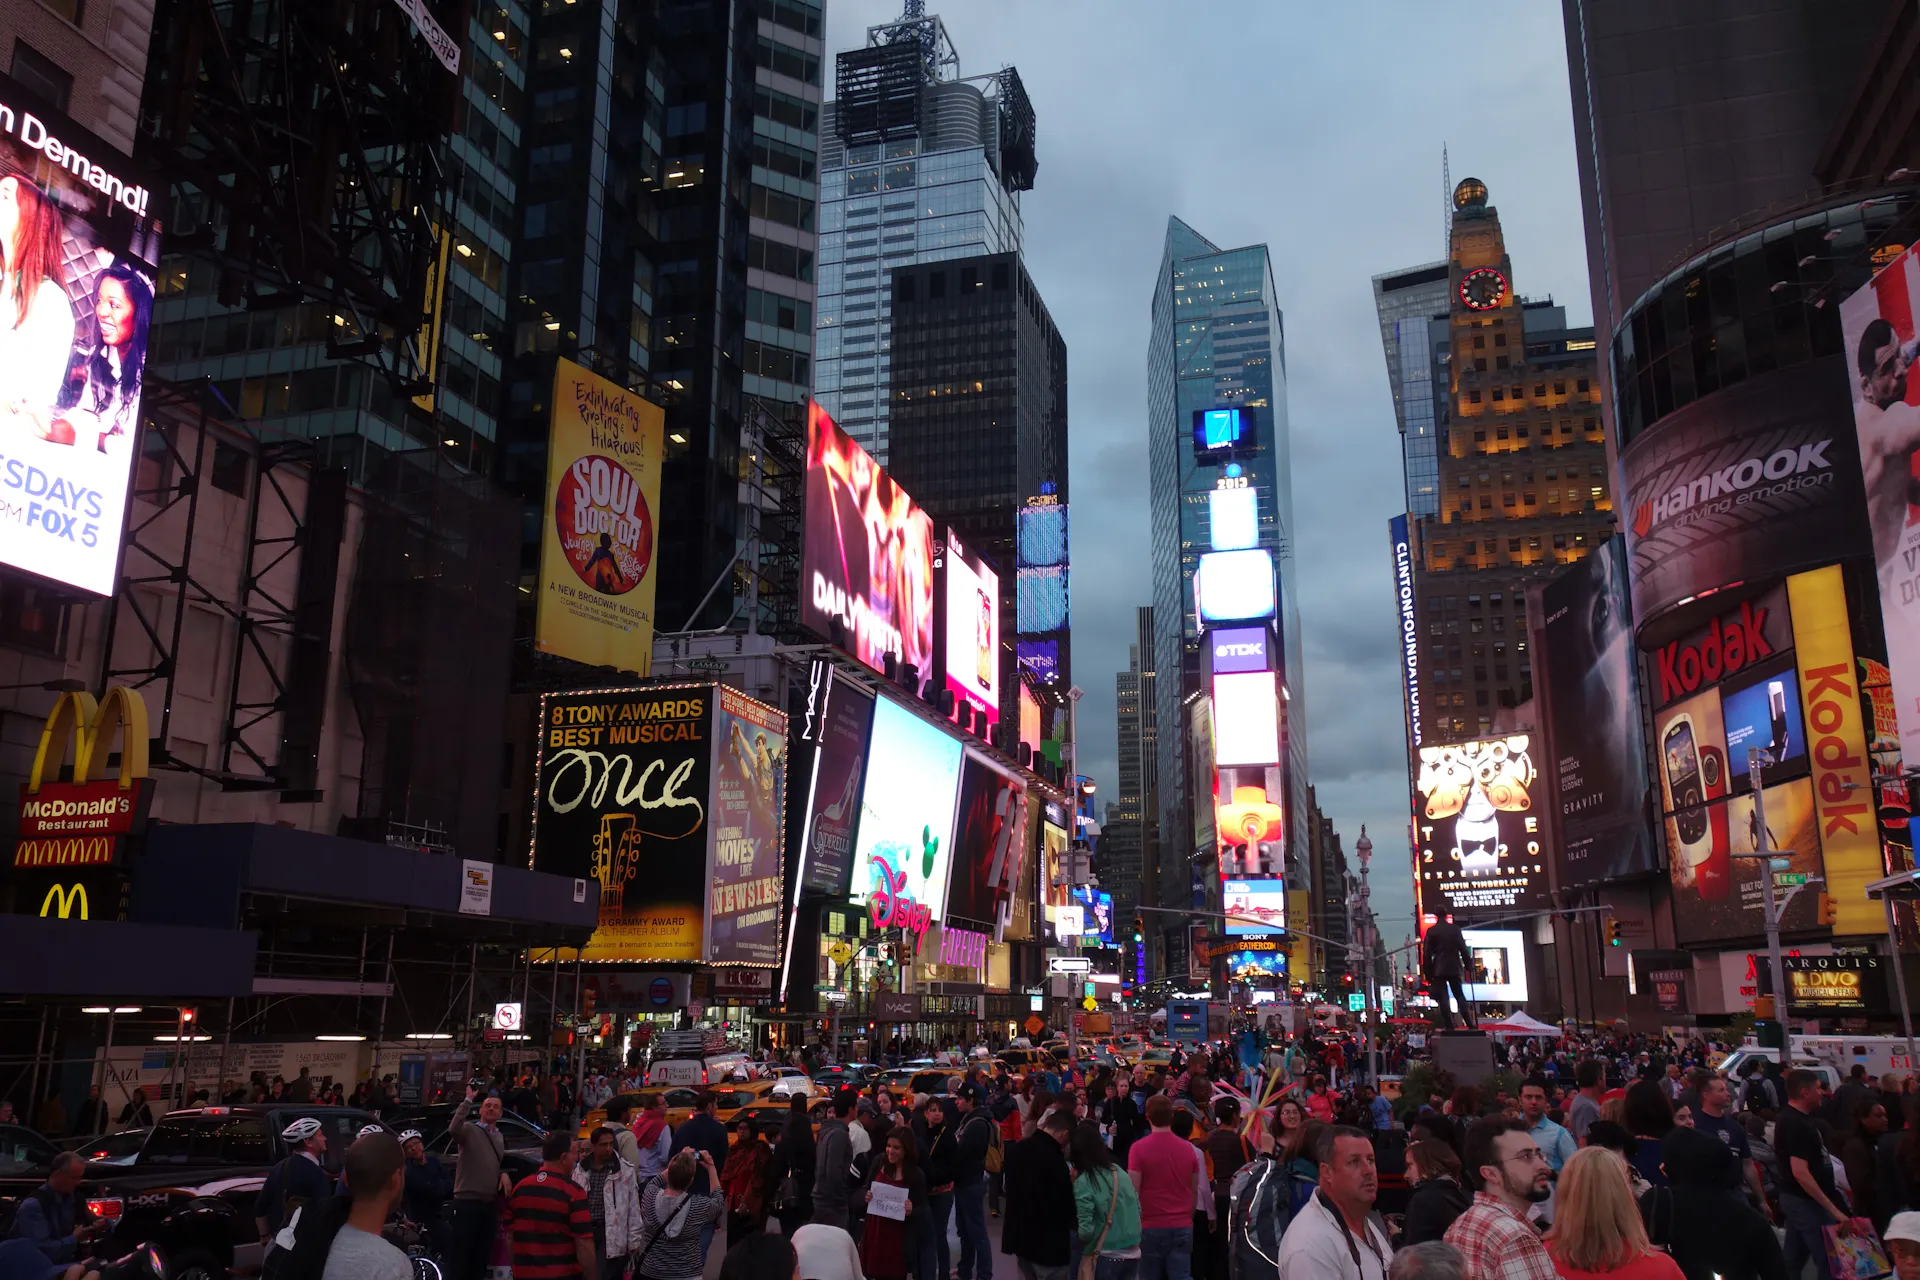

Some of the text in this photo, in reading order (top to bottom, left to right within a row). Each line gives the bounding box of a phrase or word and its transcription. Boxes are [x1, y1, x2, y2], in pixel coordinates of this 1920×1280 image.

[21, 111, 149, 217] Demand!
[572, 456, 642, 526] SOUL
[1217, 477, 1248, 490] 2013
[1674, 471, 1834, 529] driving emotion
[26, 500, 78, 543] FOX
[81, 522, 100, 548] 5
[574, 503, 642, 552] DOCTOR
[564, 532, 595, 552] Journey
[550, 582, 650, 622] A NEW BROADWAY MUSICAL
[813, 570, 858, 633] DAILY
[1226, 642, 1263, 656] TDK
[1657, 601, 1775, 702] Kodak
[691, 661, 728, 670] LAMAR
[551, 698, 704, 726] 8 TONY AWARDS
[549, 722, 703, 748] BEST MUSICAL
[1804, 663, 1868, 840] Kodak
[1560, 760, 1580, 774] BULLOCK
[545, 748, 703, 814] once
[1562, 777, 1584, 791] CLOONEY
[22, 797, 130, 818] McDonald's
[1563, 792, 1604, 815] GRAVITY
[37, 817, 110, 831] Restaurant
[716, 826, 742, 841] NOTHING
[715, 837, 754, 868] MOVES
[740, 863, 752, 877] LIKE
[1424, 864, 1542, 880] EXPERIENCE
[1439, 877, 1529, 891] JUSTIN TIMBERLAKE
[1740, 881, 1754, 893] BUILT
[712, 876, 779, 916] NEWSIES
[1453, 899, 1502, 908] SEPTEMBER
[870, 856, 932, 957] Disney
[608, 918, 648, 927] GRAMMY
[651, 917, 685, 927] AWARD
[736, 908, 777, 930] ON BROADWAY
[611, 926, 648, 936] THEATER
[649, 926, 680, 936] ALBUM
[940, 925, 987, 969] FOREVER
[1793, 971, 1859, 987] IL DIVO
[1795, 987, 1856, 998] A MUSICAL AFFAIR
[688, 1005, 701, 1015] ATM
[885, 1003, 912, 1014] MAC
[312, 1053, 347, 1062] BROADWAY
[668, 1066, 692, 1074] Stuart
